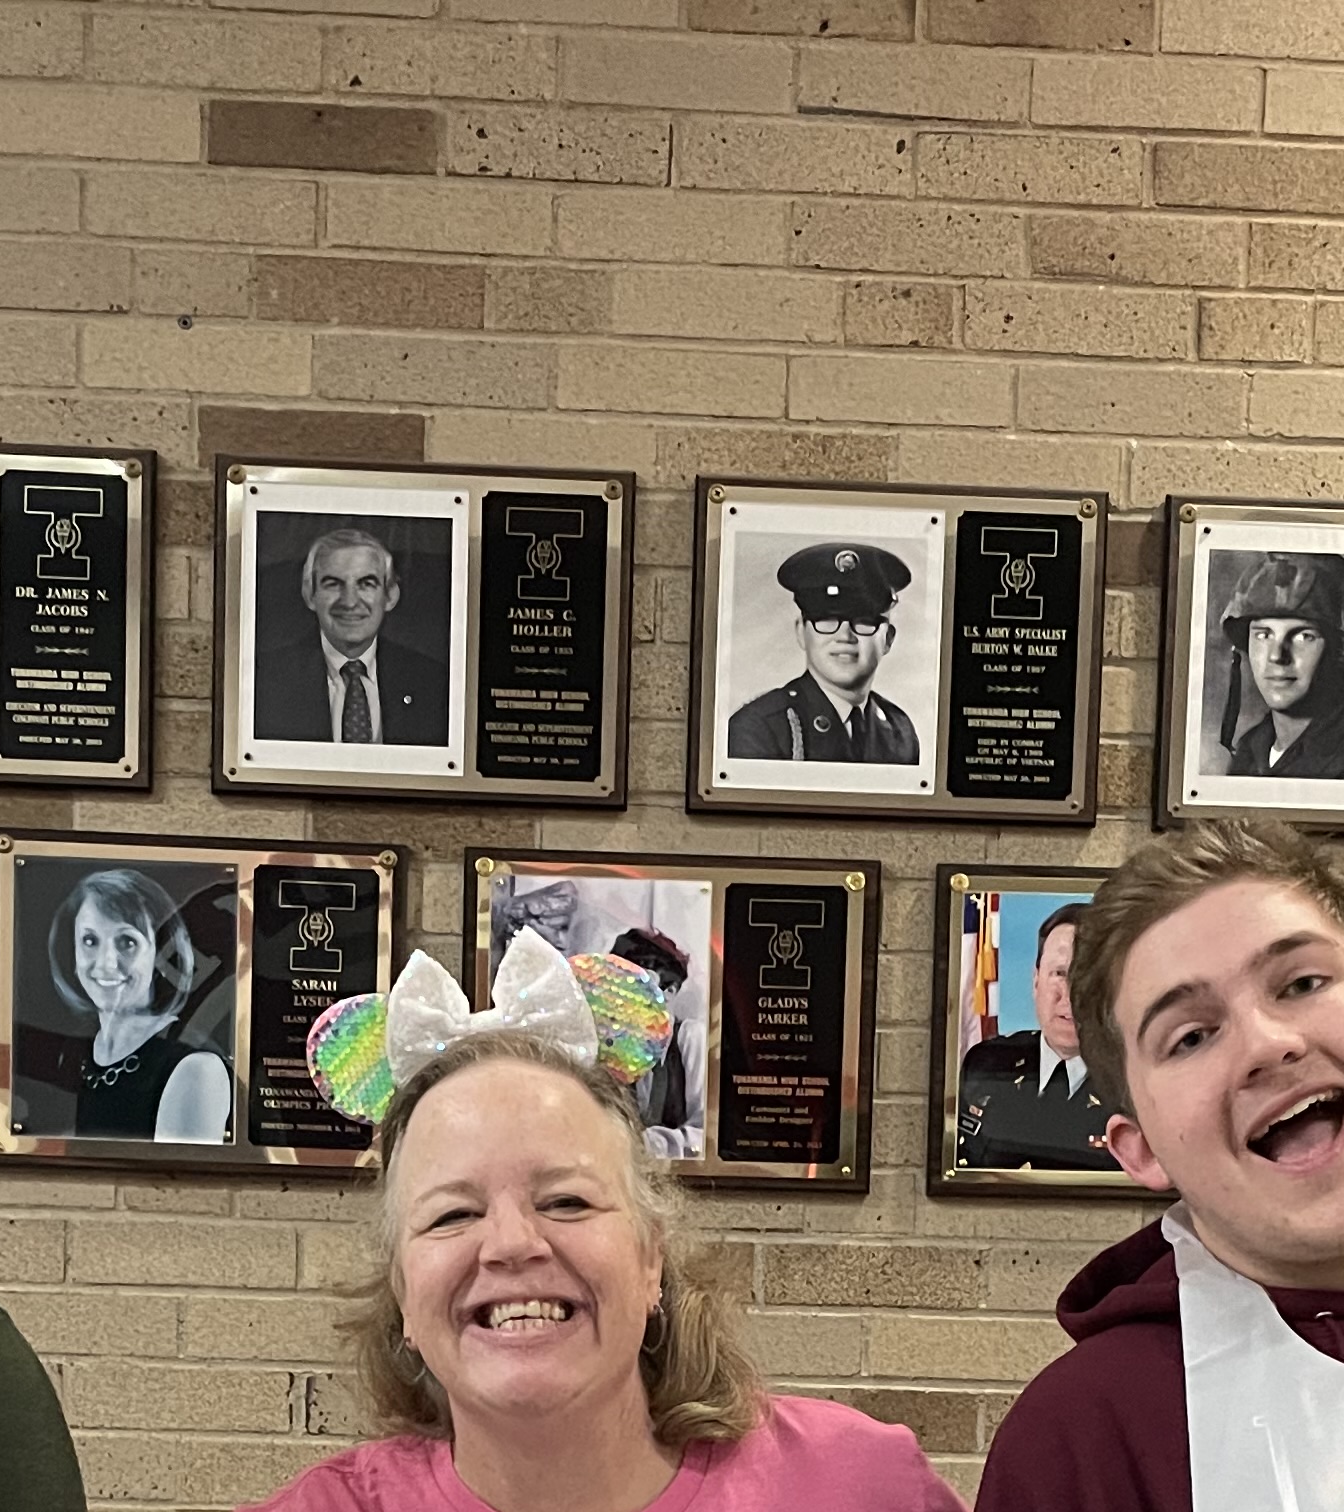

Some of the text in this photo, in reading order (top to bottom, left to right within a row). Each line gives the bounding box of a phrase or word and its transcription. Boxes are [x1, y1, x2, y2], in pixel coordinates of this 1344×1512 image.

[16, 587, 109, 601] DR. JAMES N.
[36, 604, 88, 616] JACOBS
[507, 608, 576, 621] JAMES C.
[31, 625, 55, 633] CLASS
[513, 624, 572, 637] HOLLER
[964, 626, 1067, 641] U.S. ARMY SPECIALIST
[972, 643, 1009, 655] BURTON
[1028, 645, 1058, 656] DALKE
[983, 664, 1007, 672] CLASS
[292, 979, 337, 992] SARAH
[758, 997, 808, 1009] GLADYS
[758, 1013, 808, 1025] PARKER
